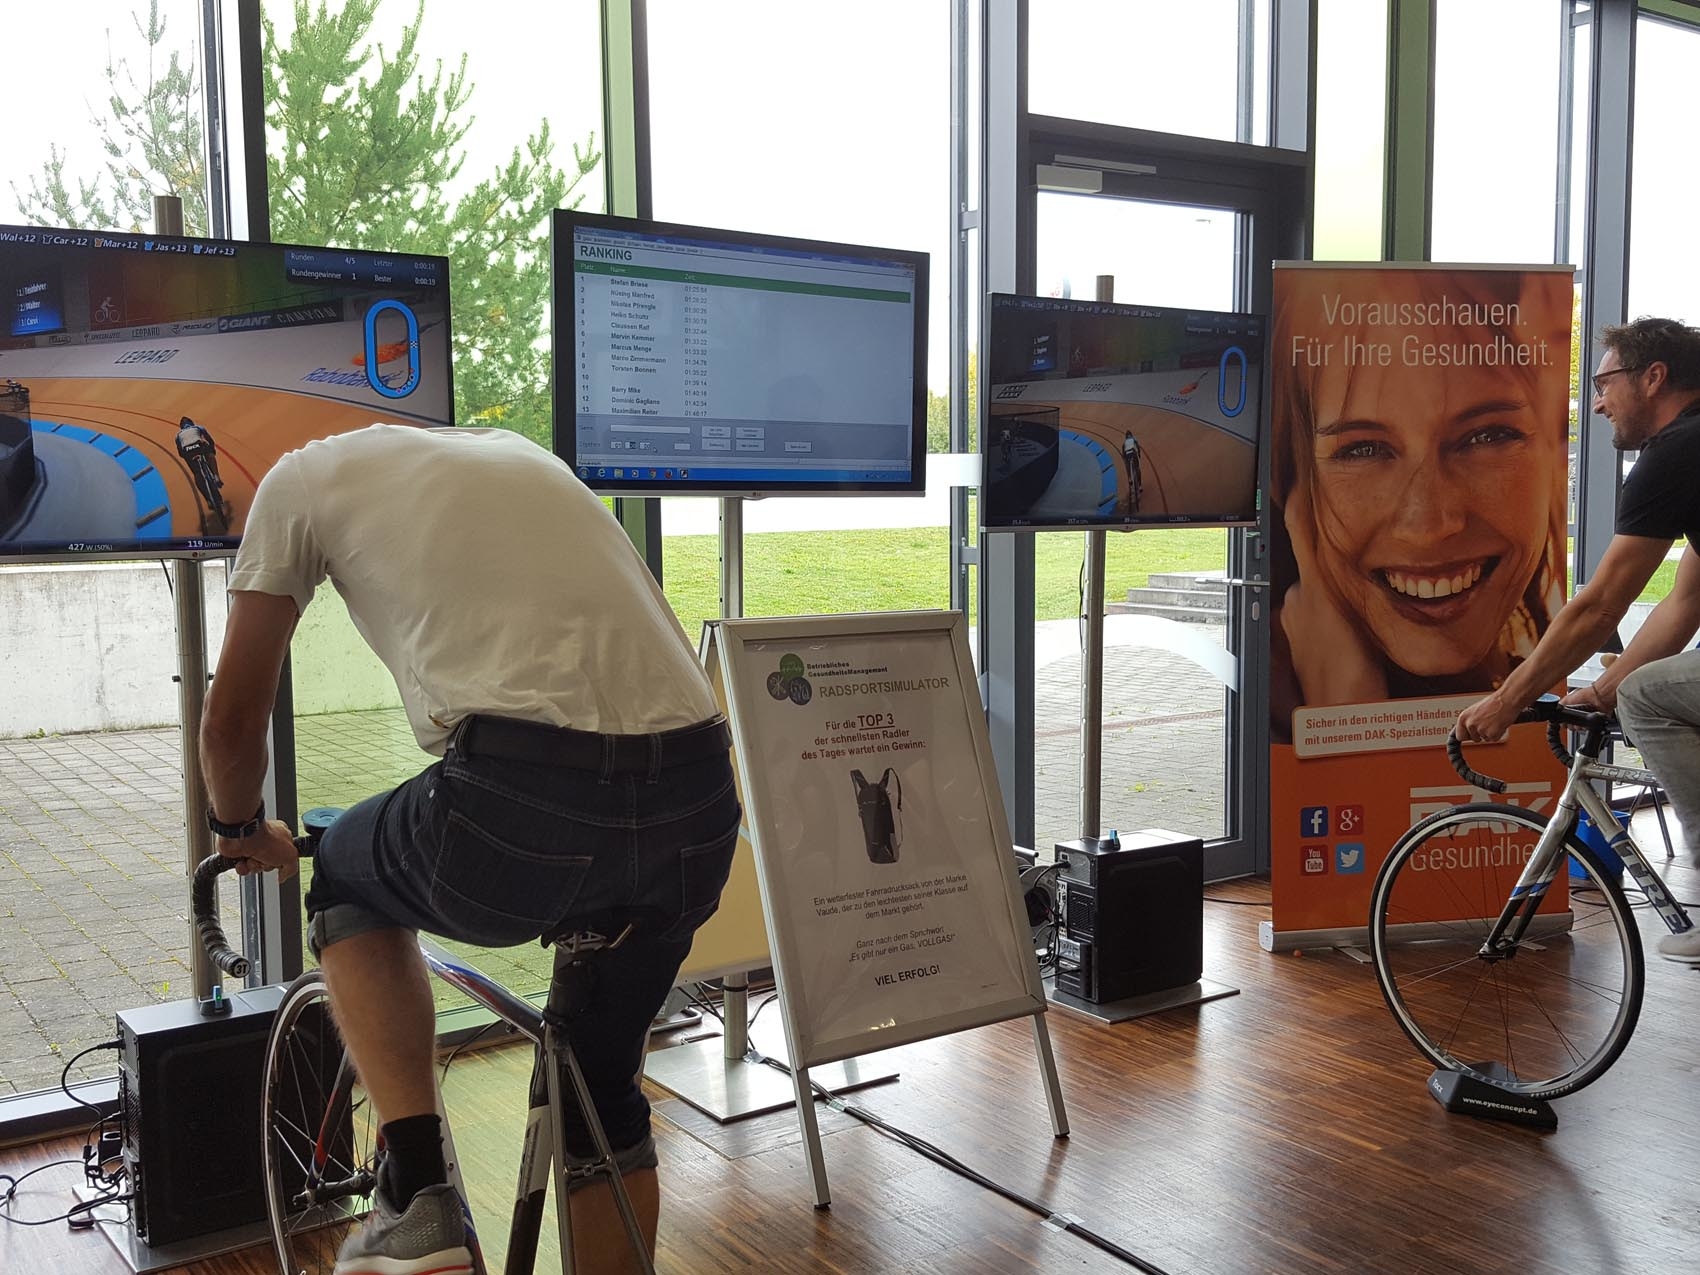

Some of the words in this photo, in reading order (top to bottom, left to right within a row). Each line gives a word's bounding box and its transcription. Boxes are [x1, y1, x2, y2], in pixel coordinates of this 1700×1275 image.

[204, 246, 216, 254] Jef
[291, 252, 314, 261] Runden
[580, 246, 632, 260] RANKING
[292, 269, 342, 280] Rundengewinner
[1322, 294, 1528, 326] Vorausschauen.
[230, 316, 271, 328] GIANT
[114, 349, 180, 364] LEOPARD
[1292, 336, 1332, 366] Für
[1344, 336, 1392, 366] Ihre
[1402, 334, 1554, 366] Gesundheit.
[807, 662, 850, 670] Betriebliches
[808, 666, 888, 677] GesundheitsManagement
[820, 677, 949, 698] RADSPORTSIMULATOR
[826, 720, 842, 731] Für
[843, 719, 856, 729] die
[858, 714, 883, 728] TOP
[887, 713, 895, 725] 3
[1306, 717, 1336, 730] Sicher
[1339, 716, 1348, 726] in
[1350, 714, 1368, 726] den
[1370, 712, 1414, 726] richtigen
[1416, 708, 1451, 721] Händen
[815, 736, 828, 746] der
[831, 732, 880, 744] schnellsten
[882, 729, 910, 740] Radler
[1305, 734, 1320, 745] mit
[1322, 731, 1362, 744] unserem
[1364, 724, 1457, 741] DAK-Spezialisten-
[802, 750, 818, 760] des
[820, 749, 846, 760] Tages
[848, 745, 875, 756] wartet
[877, 743, 890, 753] ein
[892, 740, 926, 751] Gewinn:
[1600, 767, 1656, 782] TRE
[1308, 849, 1321, 858] You
[1410, 836, 1536, 871] Gesundhe
[1306, 860, 1323, 870] Tube
[814, 896, 825, 906] Ein
[933, 876, 945, 886] der
[1620, 845, 1688, 931] TRE
[841, 903, 853, 913] der
[854, 903, 863, 911] zu
[863, 900, 876, 909] den
[934, 886, 956, 896] Klasse
[957, 884, 968, 893] auf
[865, 910, 881, 920] dem
[881, 907, 901, 918] Markt
[856, 939, 874, 949] Ganz
[876, 935, 892, 946] nach
[893, 932, 908, 942] dem
[861, 950, 874, 961] gibt
[876, 948, 888, 956] nur
[888, 945, 899, 954] ein
[875, 974, 897, 987] VIEL
[899, 964, 941, 982] ERFOLG!
[1463, 1096, 1537, 1115] www.eyeconcept.de
